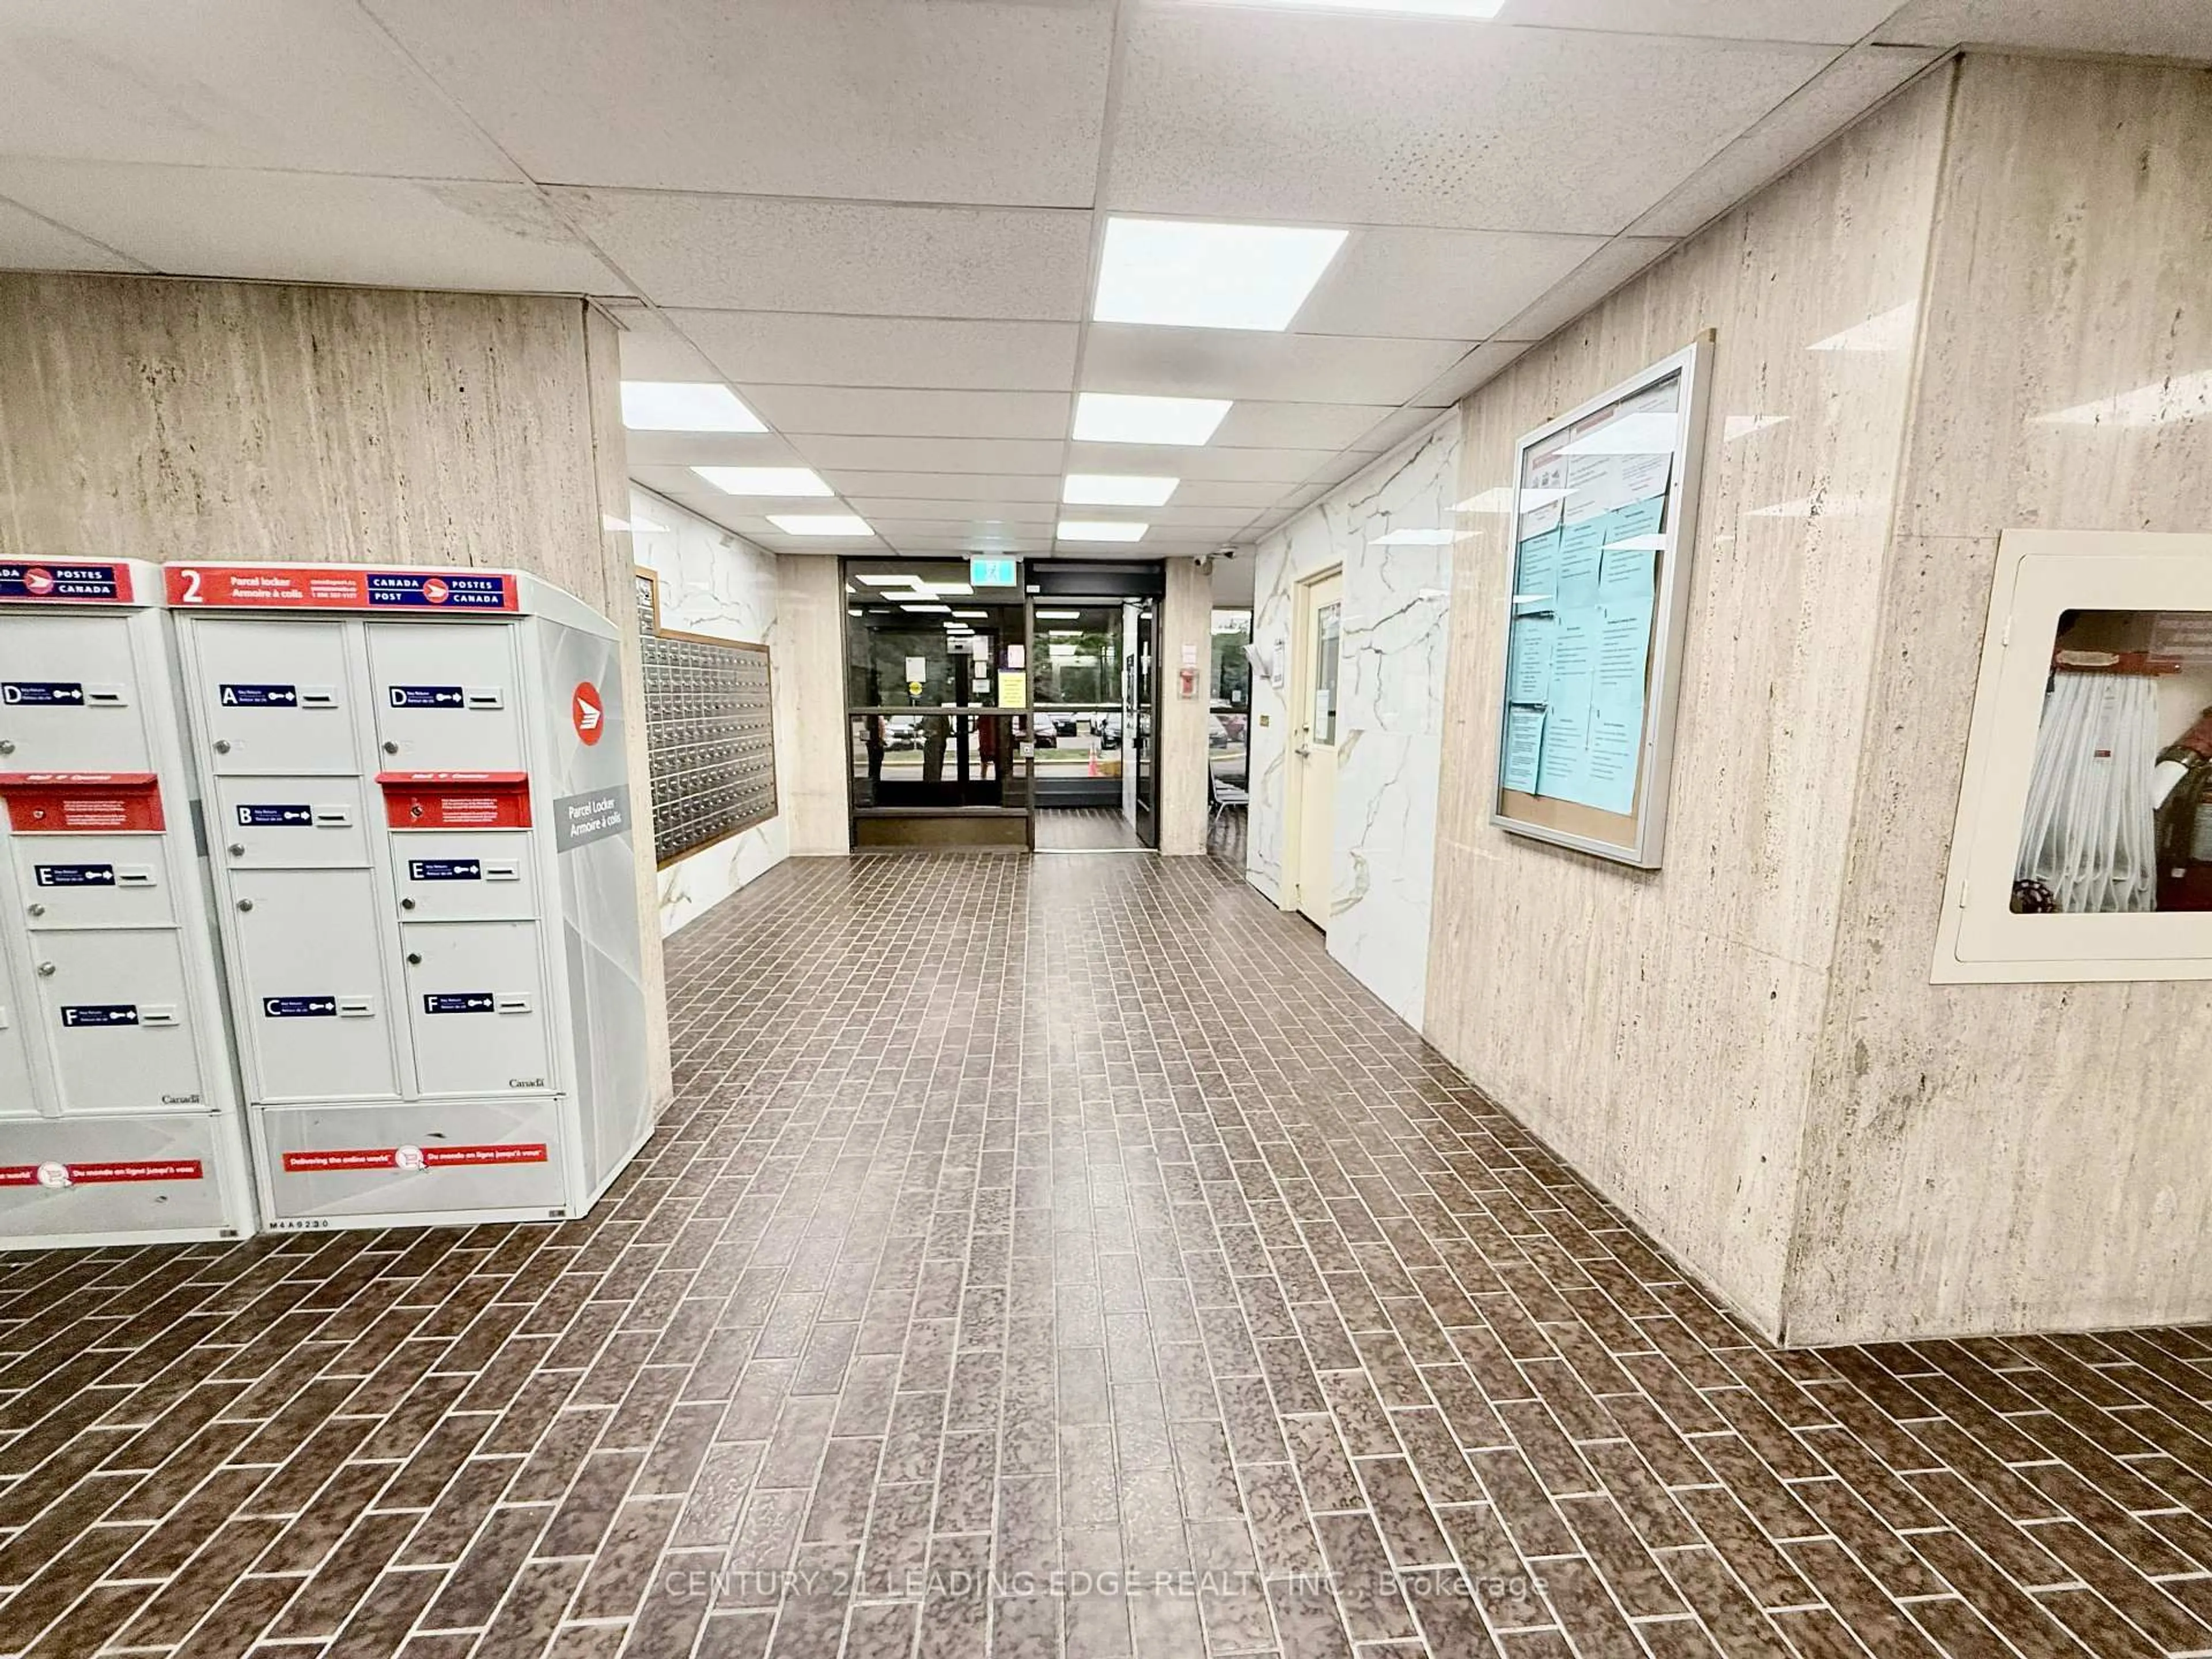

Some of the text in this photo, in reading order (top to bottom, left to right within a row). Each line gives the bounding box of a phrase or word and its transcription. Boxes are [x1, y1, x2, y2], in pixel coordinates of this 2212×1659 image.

[56, 570, 102, 579] POSTES
[231, 577, 291, 586] Parcel locker
[58, 585, 111, 593] CANADA
[181, 569, 203, 603] 2
[373, 579, 419, 587] CANADA
[452, 581, 493, 589] POSTES
[232, 588, 272, 599] Armoire
[281, 589, 303, 599] colis
[453, 594, 499, 603] CANADA
[4, 685, 22, 703] D
[223, 687, 238, 704] A
[391, 688, 407, 706] D
[239, 807, 252, 823] B
[569, 797, 615, 819] Parcel Locker
[570, 811, 622, 838] Armoire à colis
[39, 868, 54, 885] E
[412, 863, 425, 878] E
[267, 999, 281, 1015] C
[427, 997, 438, 1012] F
[66, 1009, 77, 1025] F
[509, 1078, 544, 1088] Canada
[162, 1094, 199, 1104] Canada
